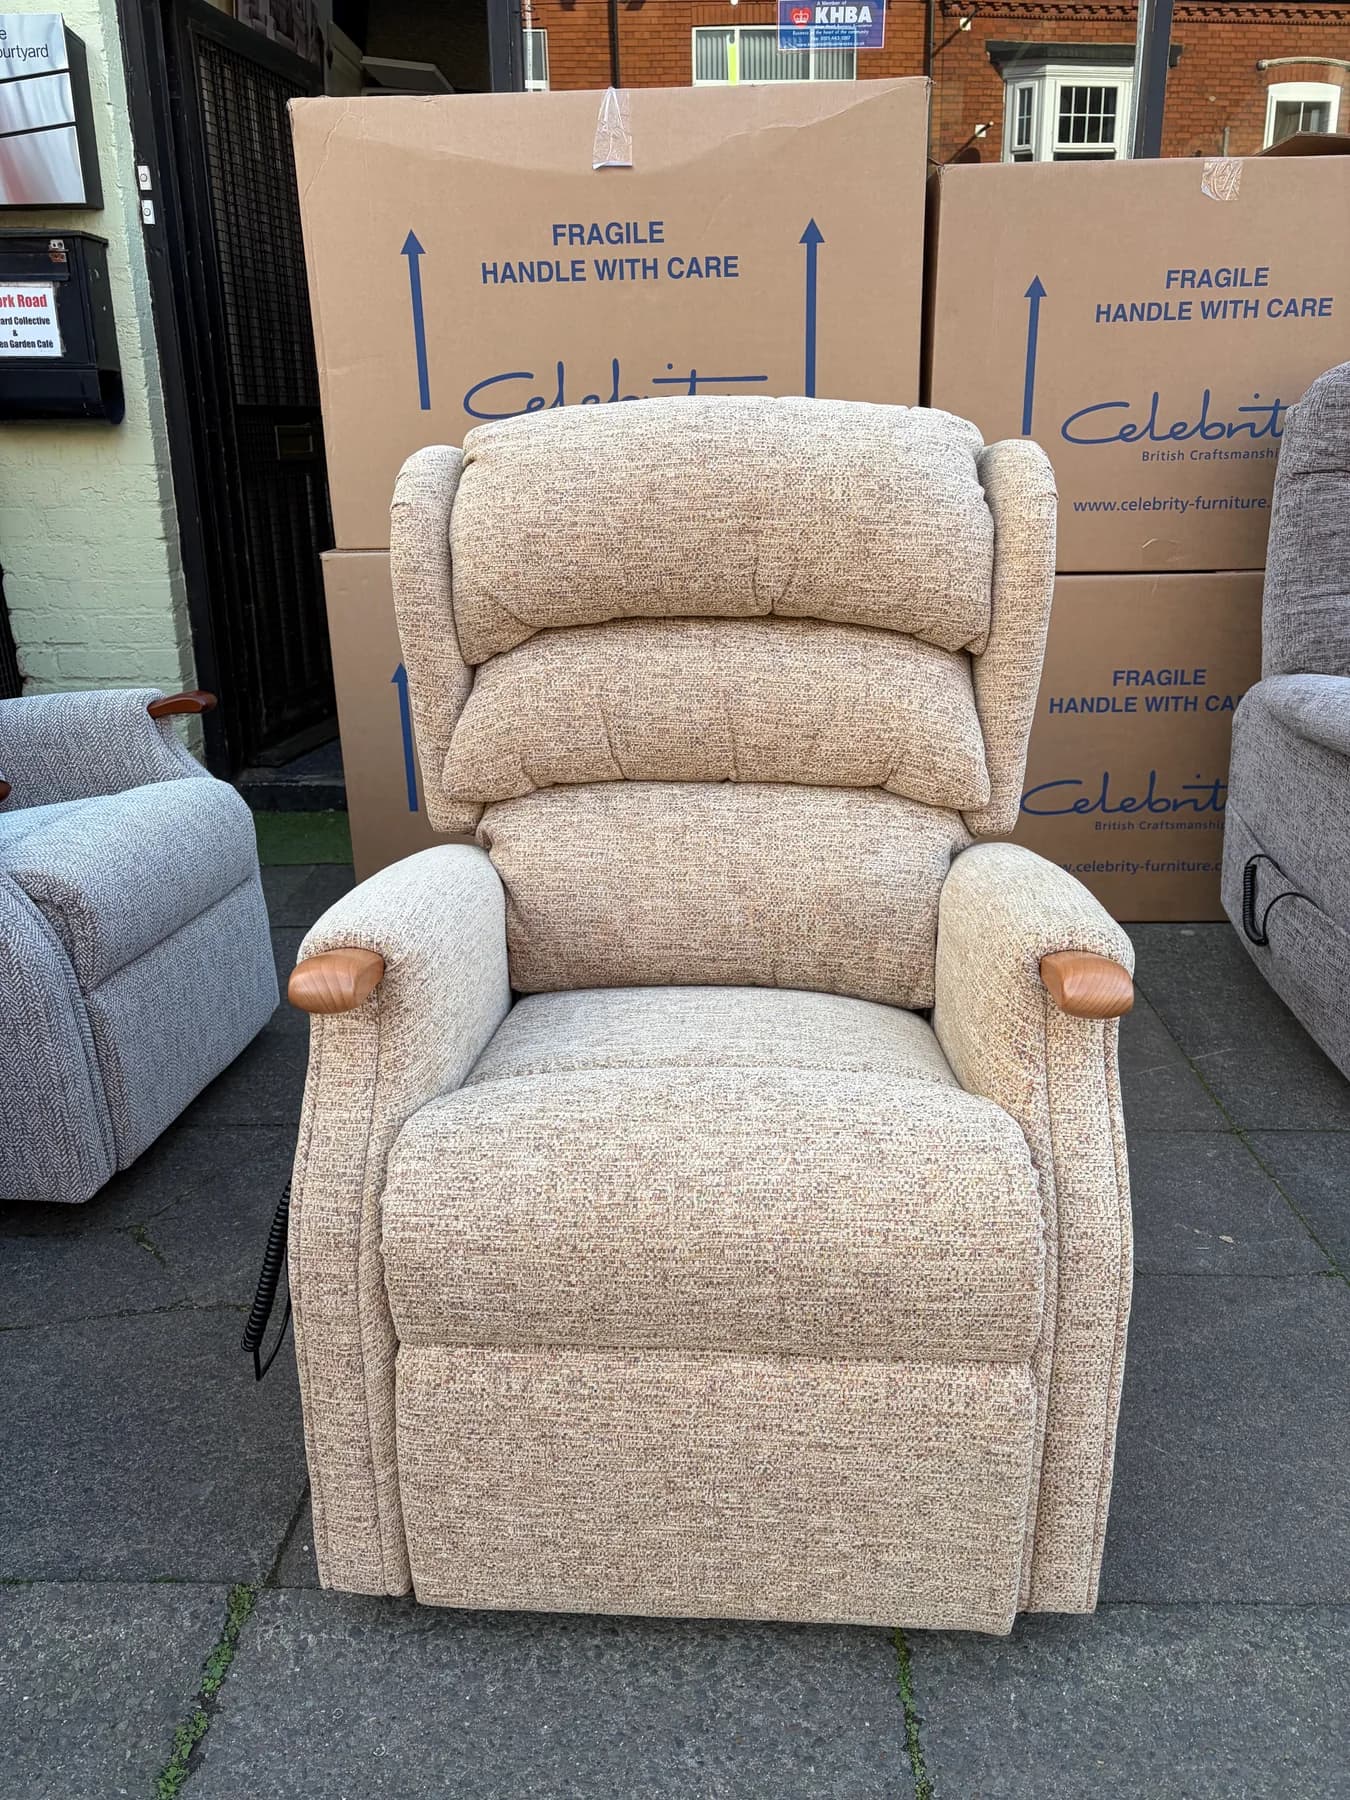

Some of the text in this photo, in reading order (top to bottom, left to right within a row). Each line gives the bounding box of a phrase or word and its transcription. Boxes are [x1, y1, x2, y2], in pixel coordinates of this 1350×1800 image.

[815, 6, 873, 23] KHBA
[552, 221, 664, 246] FRAGILE
[481, 255, 739, 284] HANDLE WITH CARE
[1165, 267, 1269, 289] FRAGILE
[17, 294, 48, 308] Road
[1095, 297, 1333, 323] HANDLE WITH CARE
[14, 316, 50, 325] Collective
[13, 329, 18, 337] &
[10, 340, 36, 349] Garden
[1061, 389, 1288, 445] Celebrit
[1142, 448, 1280, 462] British Craftsmanshi
[1112, 669, 1207, 686] FRAGILE
[1049, 695, 1245, 714] HANDLE WITH CA
[1019, 770, 1228, 816] Celebrit
[1095, 821, 1135, 831] British
